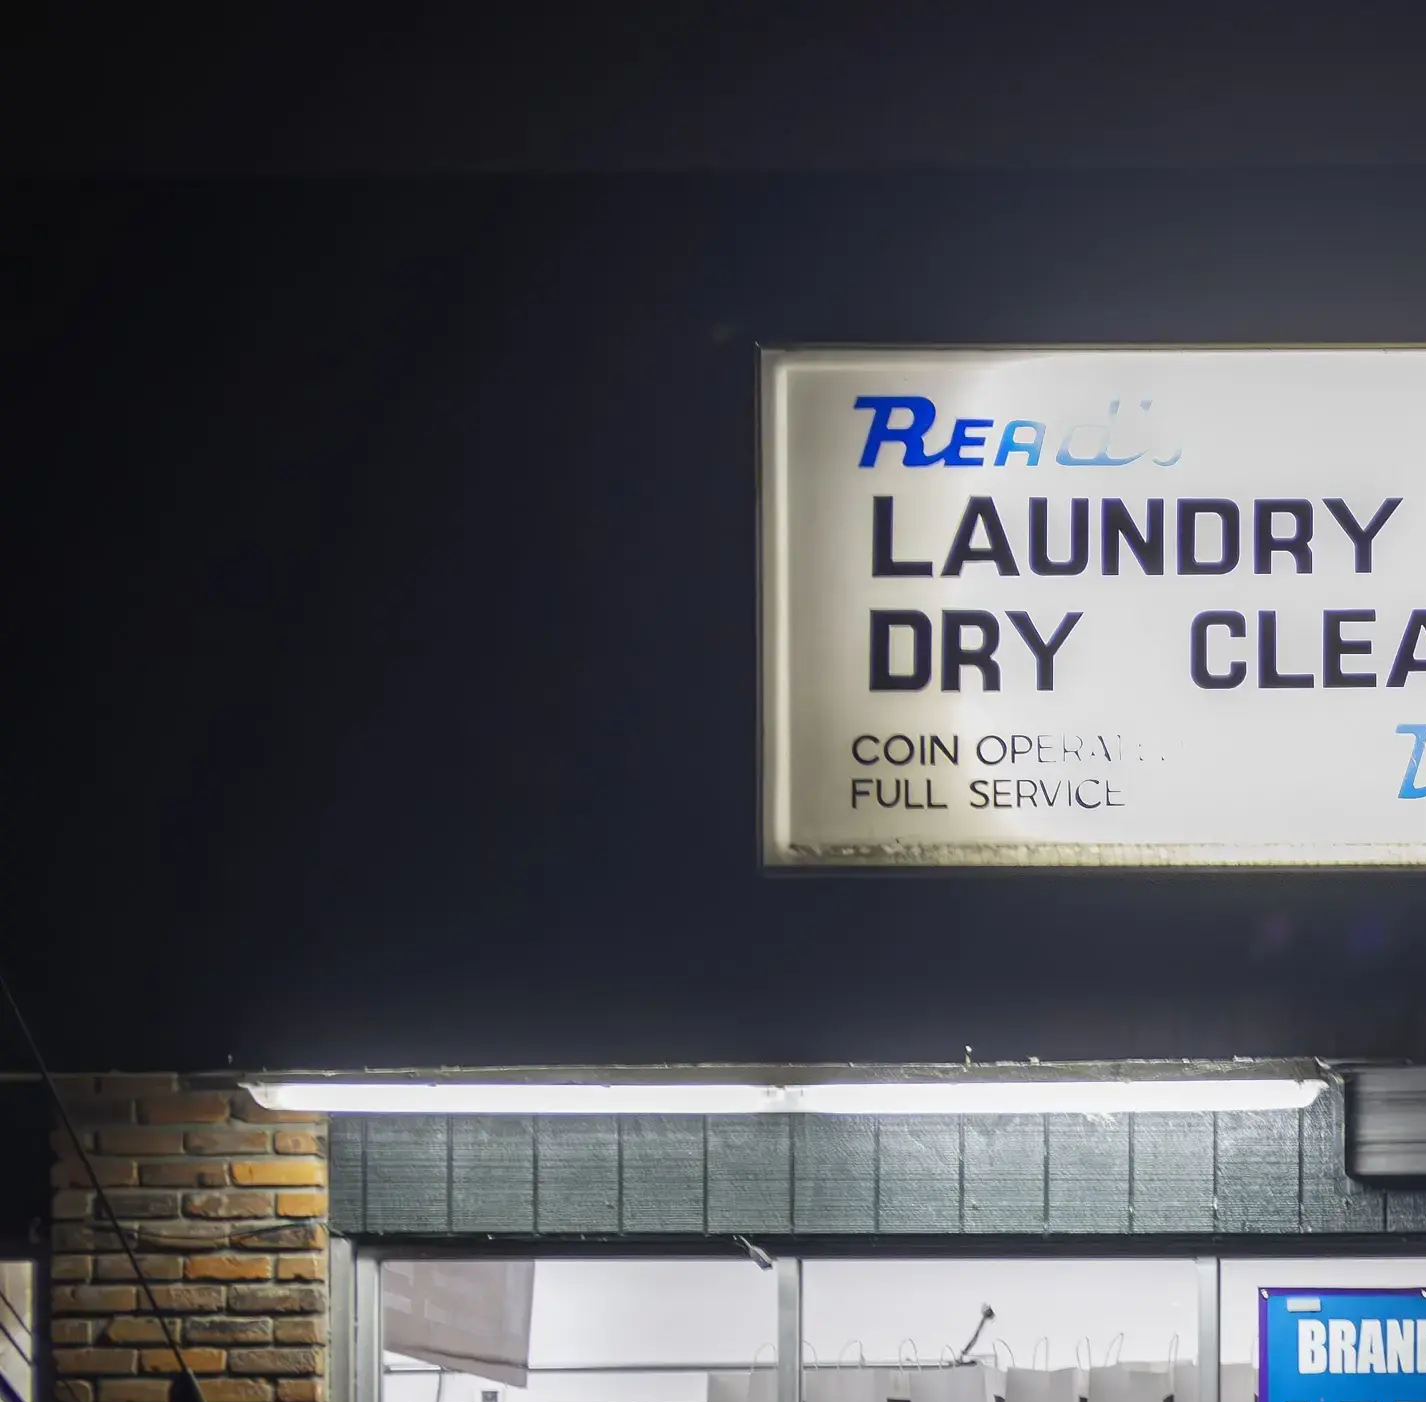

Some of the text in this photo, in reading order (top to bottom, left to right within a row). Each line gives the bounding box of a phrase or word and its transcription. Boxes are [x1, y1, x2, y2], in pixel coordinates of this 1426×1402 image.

[871, 496, 1403, 578] LAUNDRY
[868, 610, 1084, 693] DRY
[851, 734, 959, 767] COIN
[851, 778, 1126, 809] FULL SERVICE
